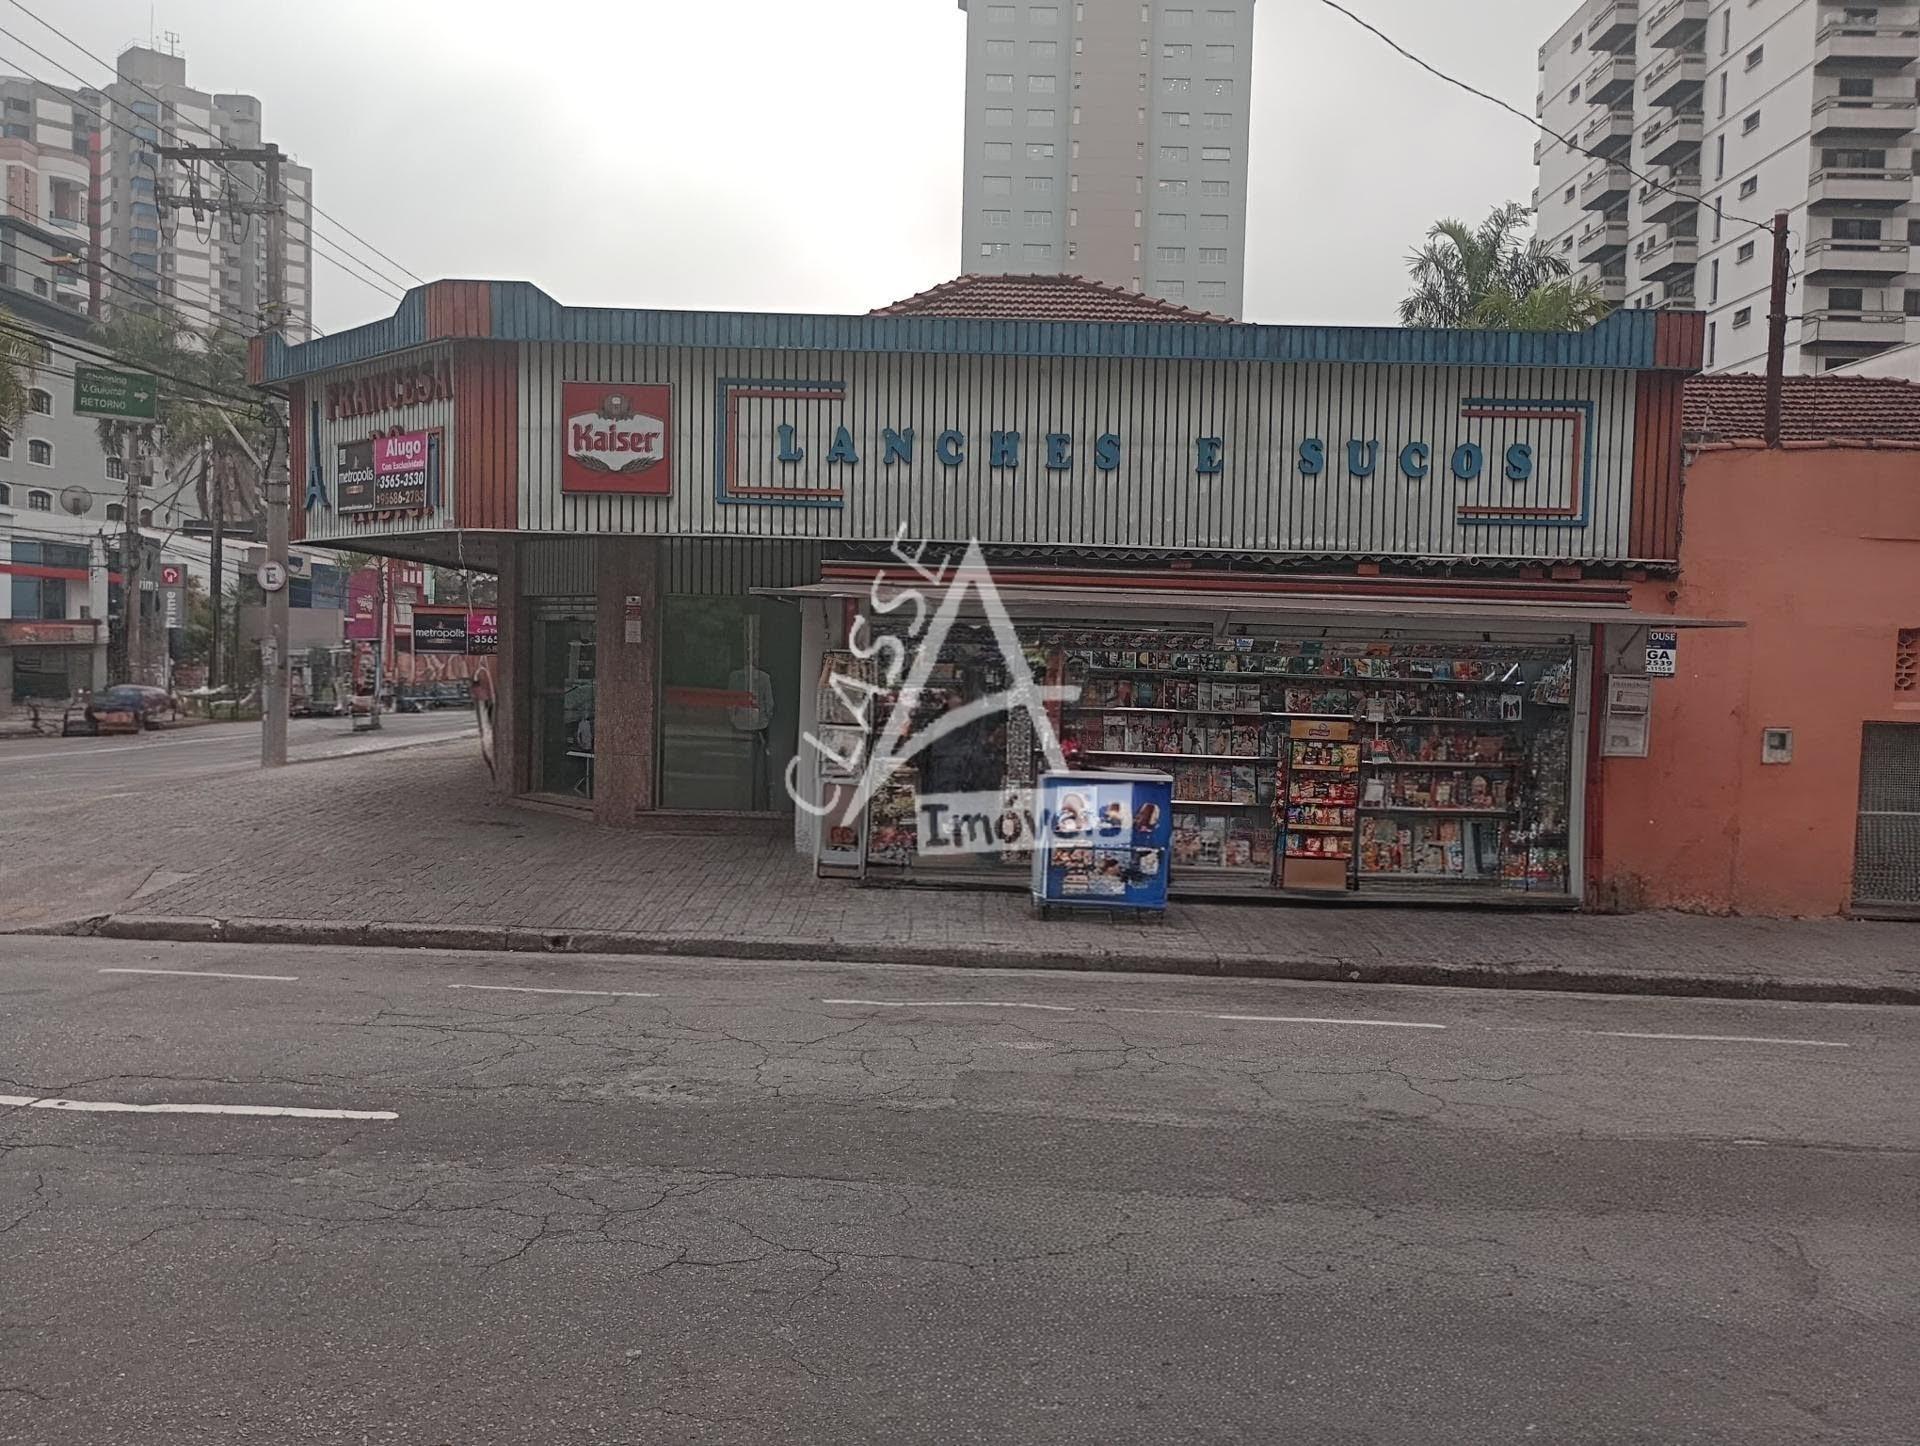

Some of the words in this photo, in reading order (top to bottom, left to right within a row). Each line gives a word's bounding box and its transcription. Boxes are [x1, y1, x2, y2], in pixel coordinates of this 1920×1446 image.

[80, 396, 126, 410] RETORNO
[573, 424, 661, 453] Kaiser
[386, 438, 421, 459] Alugo
[777, 424, 1121, 470] LANCHES
[1196, 437, 1223, 474] E
[1298, 437, 1532, 480] SUCOS
[339, 467, 374, 484] metropolis
[380, 471, 424, 489] 3565-3530
[164, 591, 182, 628] prime
[415, 628, 466, 638] metropolis
